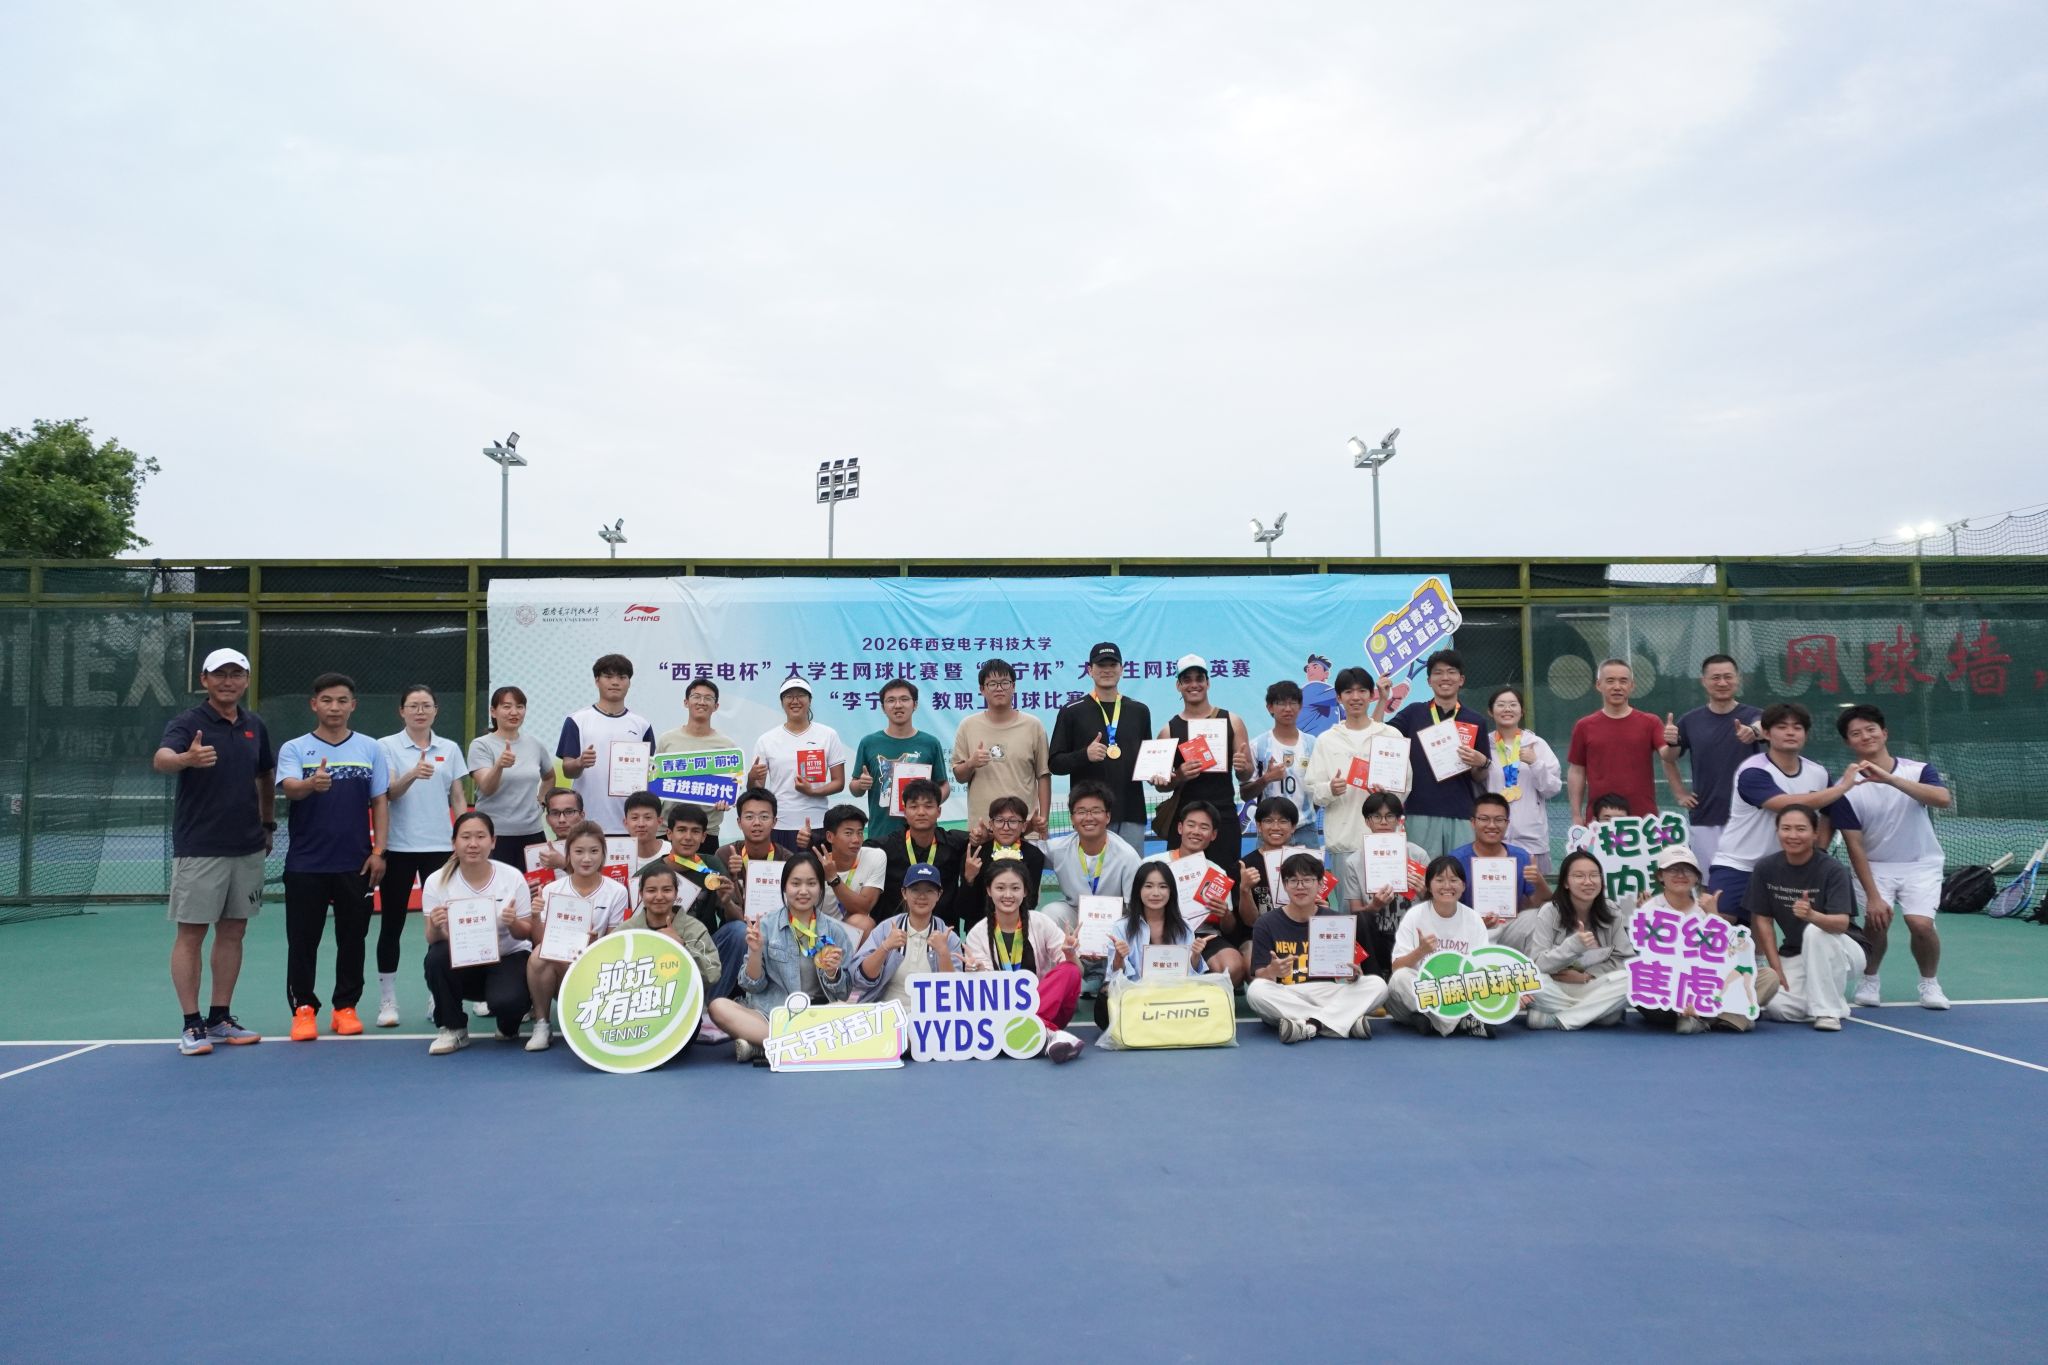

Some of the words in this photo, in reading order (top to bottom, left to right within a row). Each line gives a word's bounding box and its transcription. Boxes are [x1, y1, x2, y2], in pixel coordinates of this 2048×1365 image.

[862, 637, 1052, 651] 2026年西安电子科技大学
[0, 623, 178, 707] NEX
[662, 778, 734, 799] 奋进新时代
[1281, 776, 1296, 794] 10
[458, 915, 487, 925] 荣誉证书
[557, 912, 583, 922] 荣誉证书
[1633, 910, 1728, 963] 拒绝
[1275, 941, 1297, 955] NEW
[660, 960, 679, 970] FUN
[592, 956, 658, 996] 敢玩
[1414, 962, 1542, 1009] 青藤网球社
[914, 978, 1031, 1014] TENNIS
[1629, 961, 1725, 1014] 焦虑
[1142, 1007, 1209, 1021] LI-NING
[601, 1025, 649, 1042] TENNIS
[765, 1000, 906, 1068] 无界活力
[914, 1018, 995, 1052] YYDS
